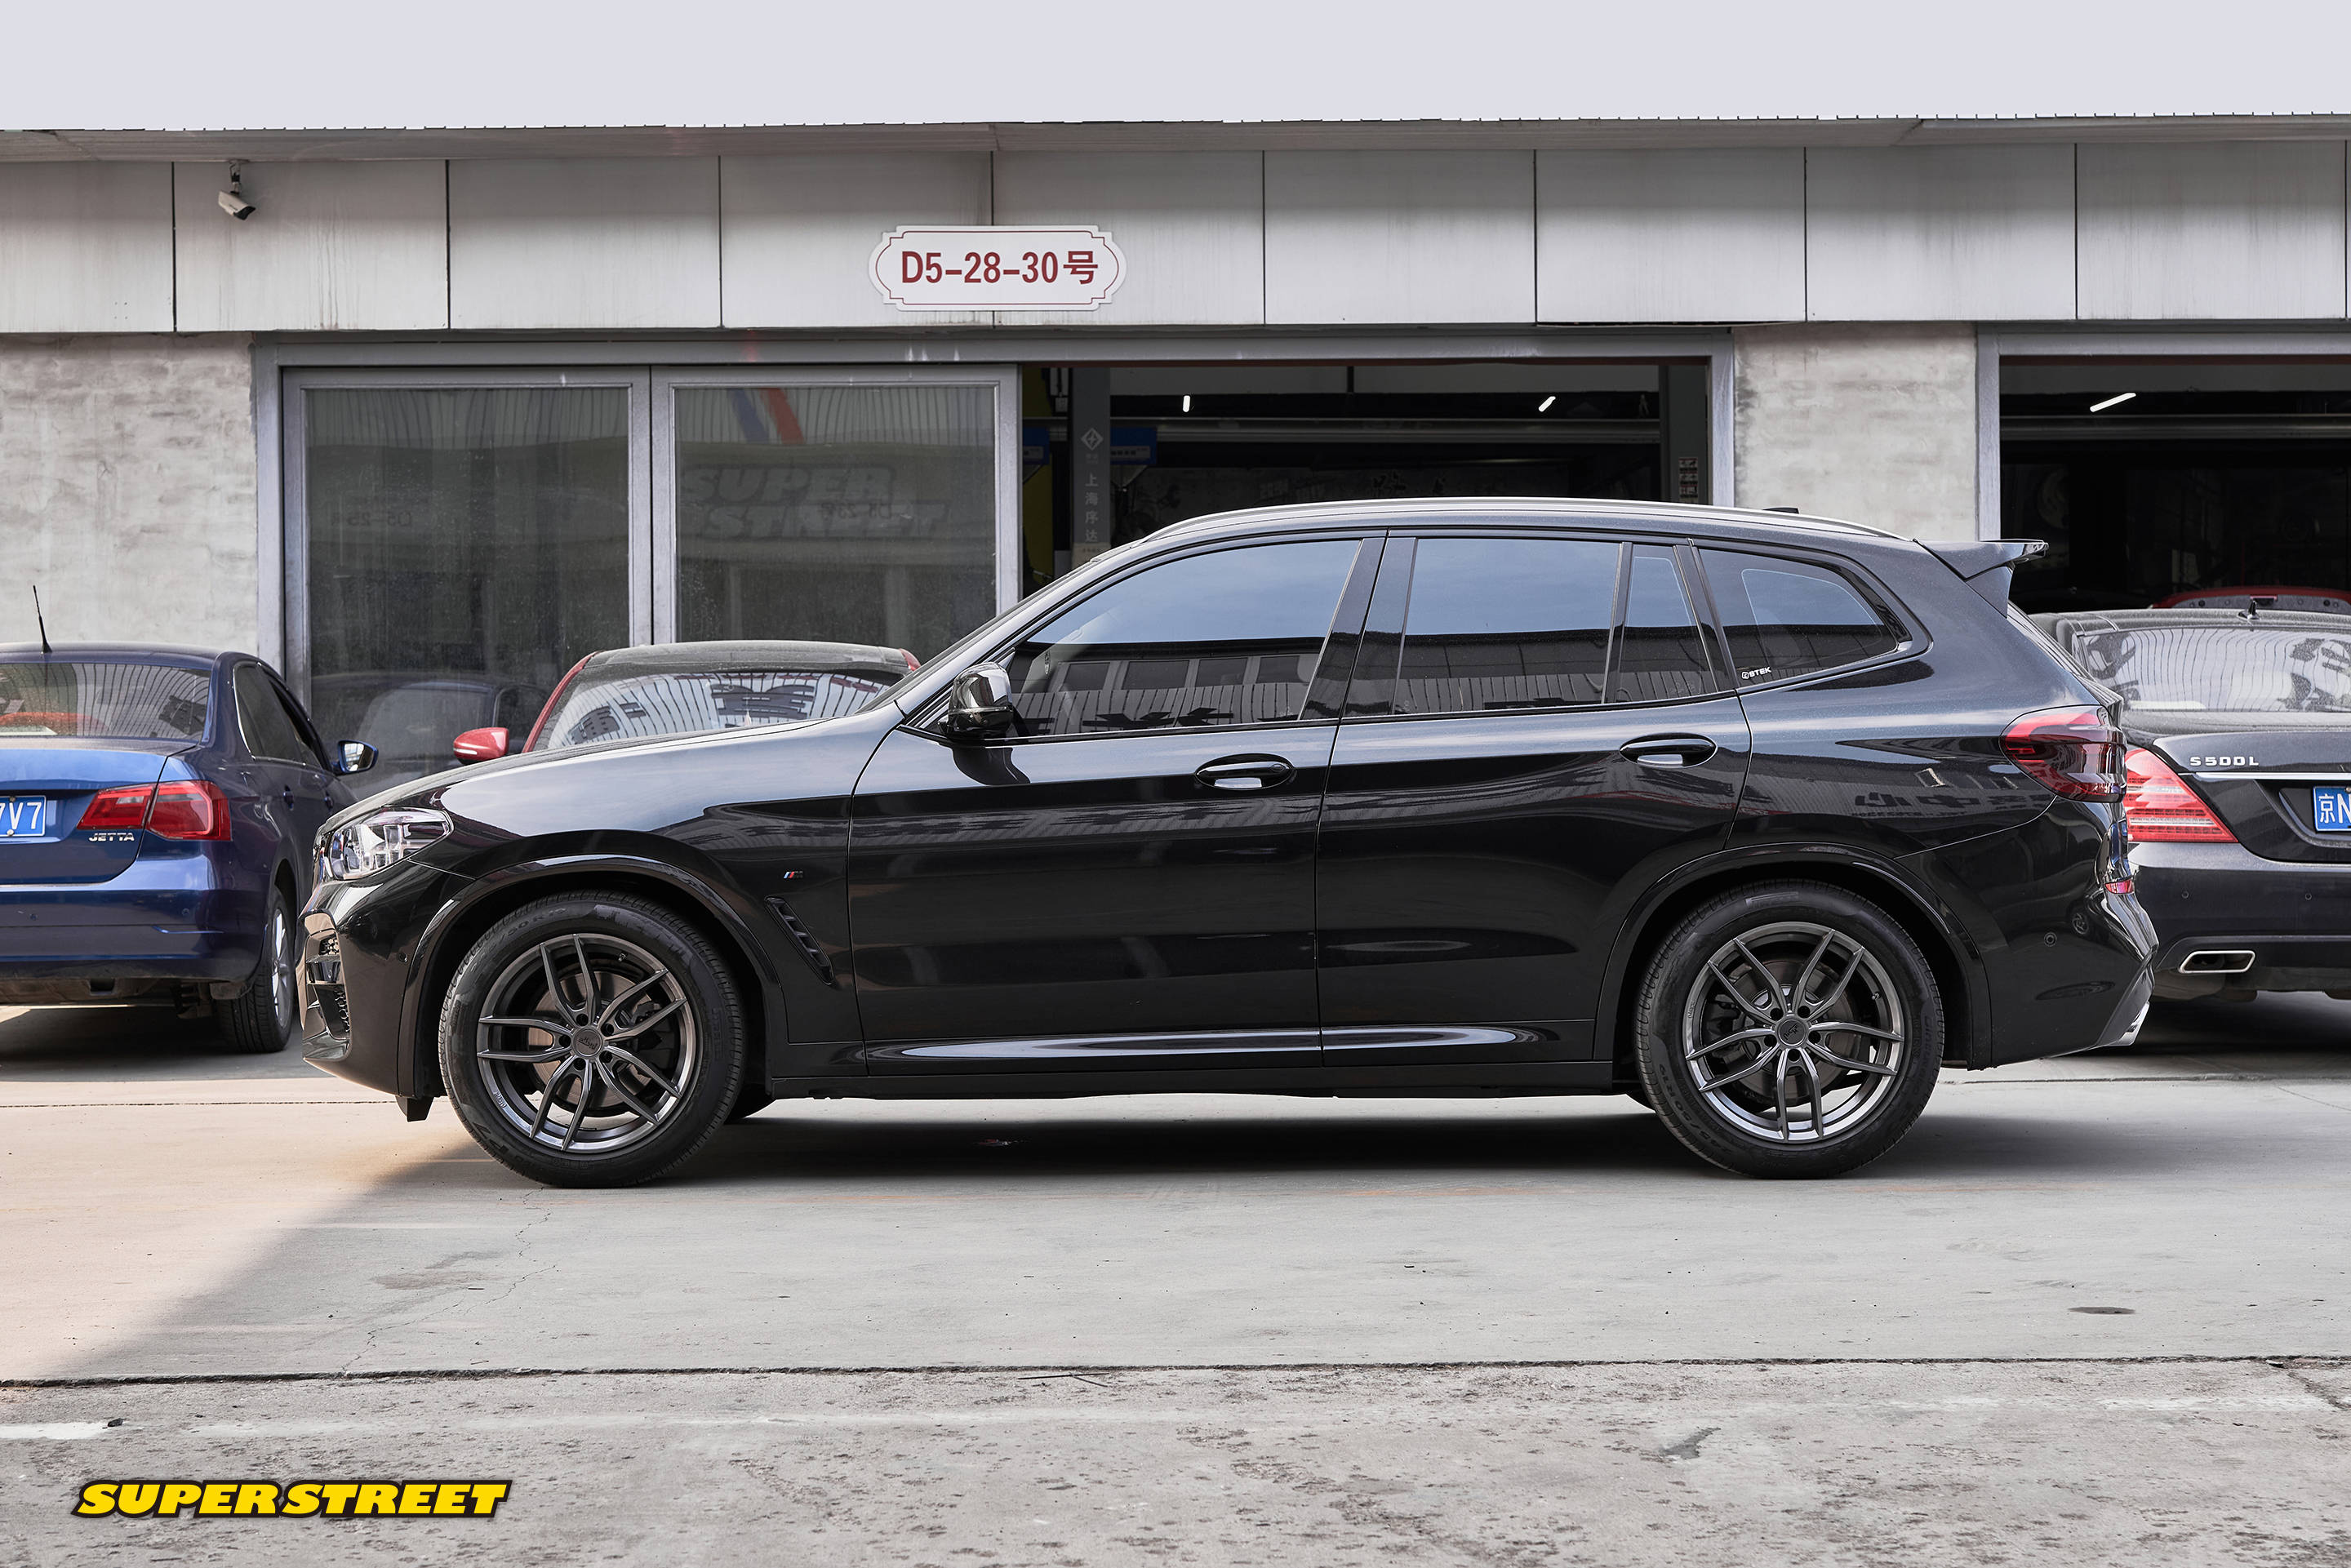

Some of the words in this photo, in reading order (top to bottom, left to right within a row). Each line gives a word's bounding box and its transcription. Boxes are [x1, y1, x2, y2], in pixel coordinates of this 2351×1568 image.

[901, 250, 1099, 285] D5-28-30号
[681, 467, 891, 502] SUPER
[88, 832, 136, 842] JETTA
